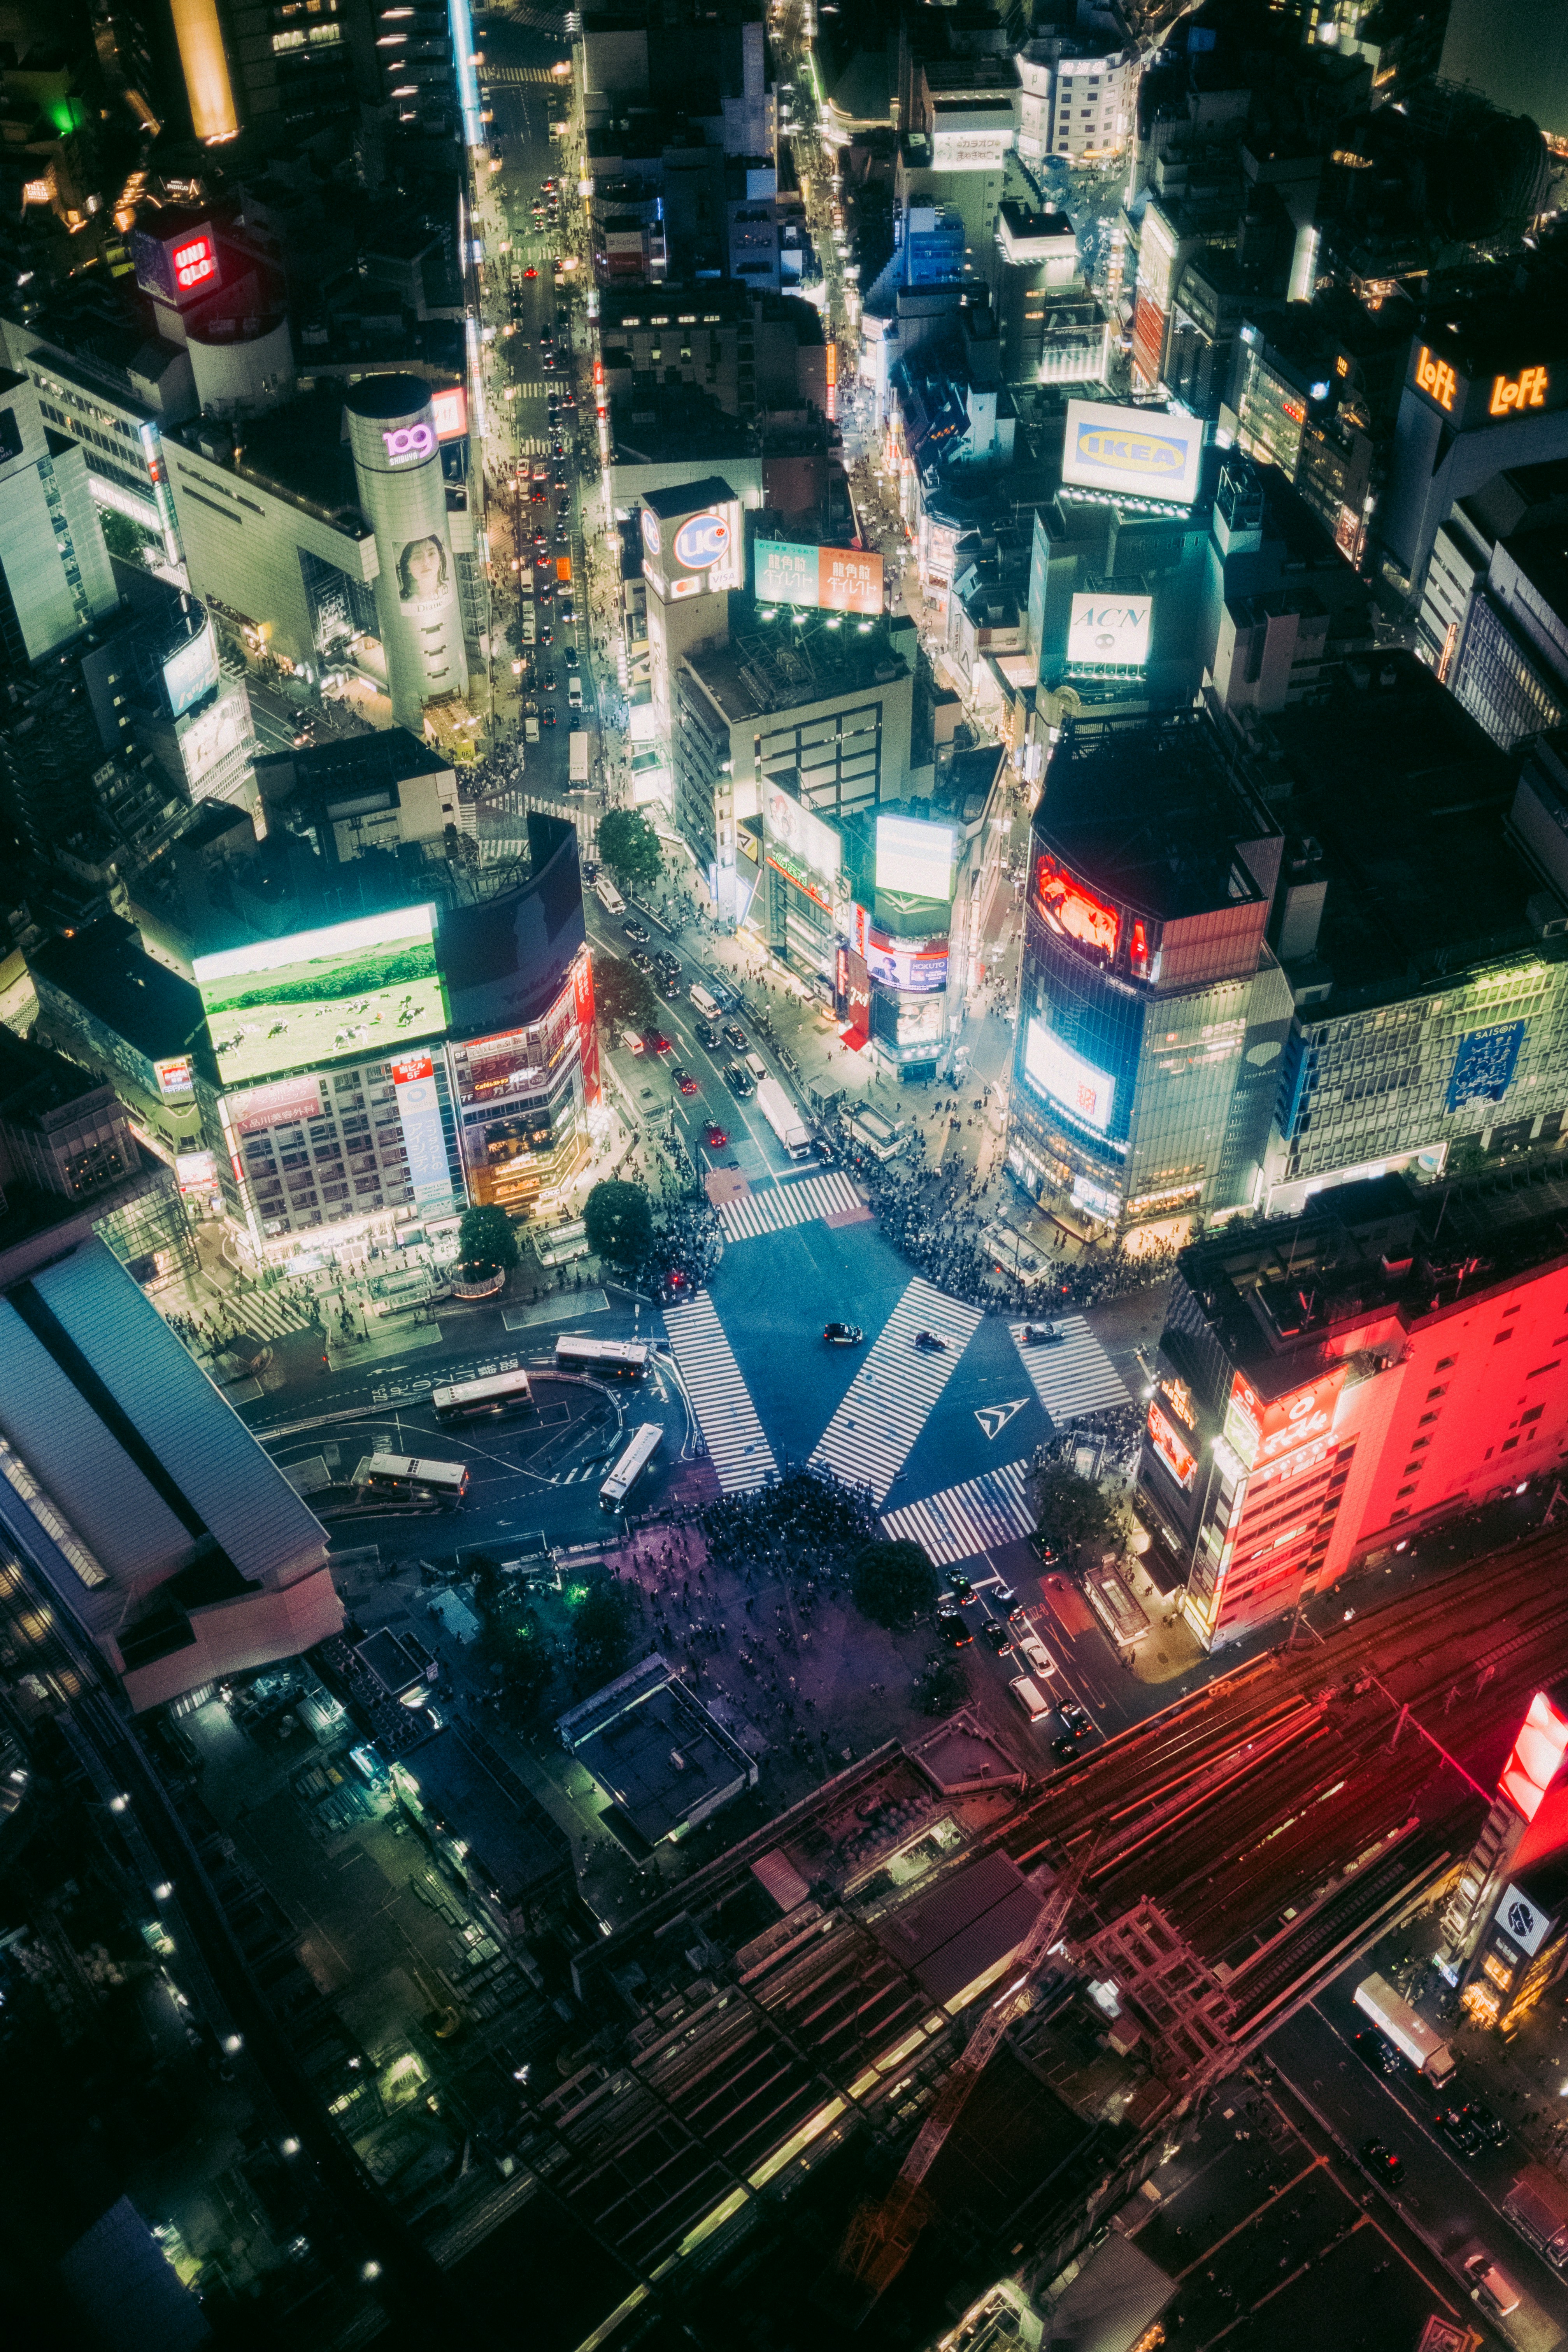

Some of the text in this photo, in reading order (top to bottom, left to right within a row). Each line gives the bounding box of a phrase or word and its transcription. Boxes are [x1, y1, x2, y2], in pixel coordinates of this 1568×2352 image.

[957, 151, 993, 161] まねきねこ
[175, 242, 206, 268] UNI
[178, 260, 211, 285] QLO
[471, 361, 479, 377] LABI
[382, 423, 432, 459] 109
[389, 451, 418, 466] SHIBUYA
[1087, 437, 1176, 466] IKEA
[681, 526, 727, 558] UC
[768, 553, 806, 572] 龍角散
[832, 561, 871, 581] 龍角散
[712, 573, 735, 584] VISA
[417, 601, 442, 613] Diane
[1073, 607, 1148, 628] ACN
[1474, 1023, 1517, 1040] SAISON
[454, 1051, 466, 1059] 9F
[399, 1061, 425, 1073] 当ビル
[407, 1070, 420, 1080] 5F
[1244, 1068, 1276, 1080] TSUTAYA
[164, 1083, 193, 1094] ESPACE
[461, 1093, 474, 1102] 7F
[249, 1105, 315, 1128] 品川美容外科
[407, 1122, 429, 1174] アイシティ
[427, 1119, 443, 1171] コンタクトの
[1134, 1182, 1201, 1205] STARBUCKS
